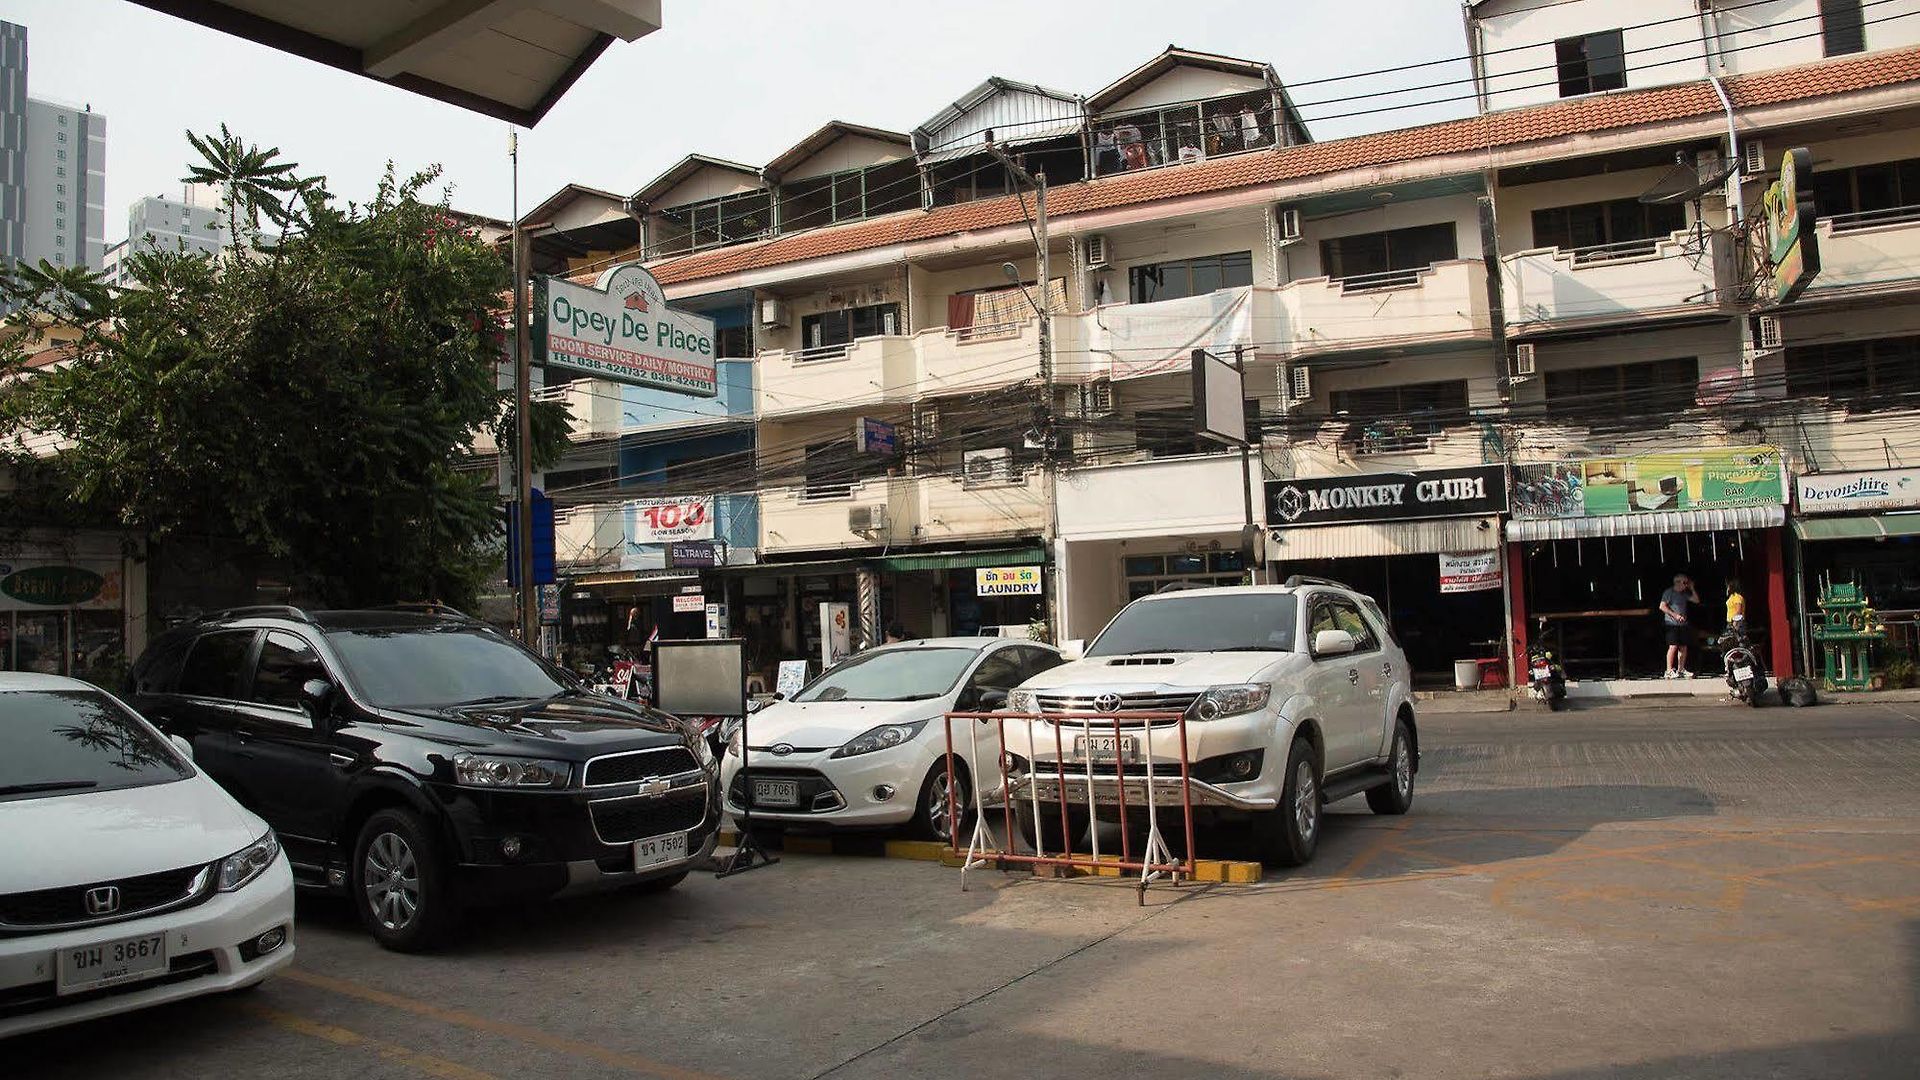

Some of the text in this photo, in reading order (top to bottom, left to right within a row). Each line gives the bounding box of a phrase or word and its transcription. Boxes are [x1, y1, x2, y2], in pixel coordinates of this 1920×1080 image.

[553, 297, 711, 355] Opey De Place
[551, 335, 713, 380] ROOM SERVICE DAILY/MONTHLY
[1307, 477, 1487, 511] MONKEY CLUB1
[1725, 488, 1745, 497] BAR
[1804, 477, 1889, 500] Devonshire
[644, 502, 705, 529] 100
[980, 583, 1038, 594] LAUNDRY
[661, 836, 683, 852] 7502
[114, 938, 161, 962] 3667
